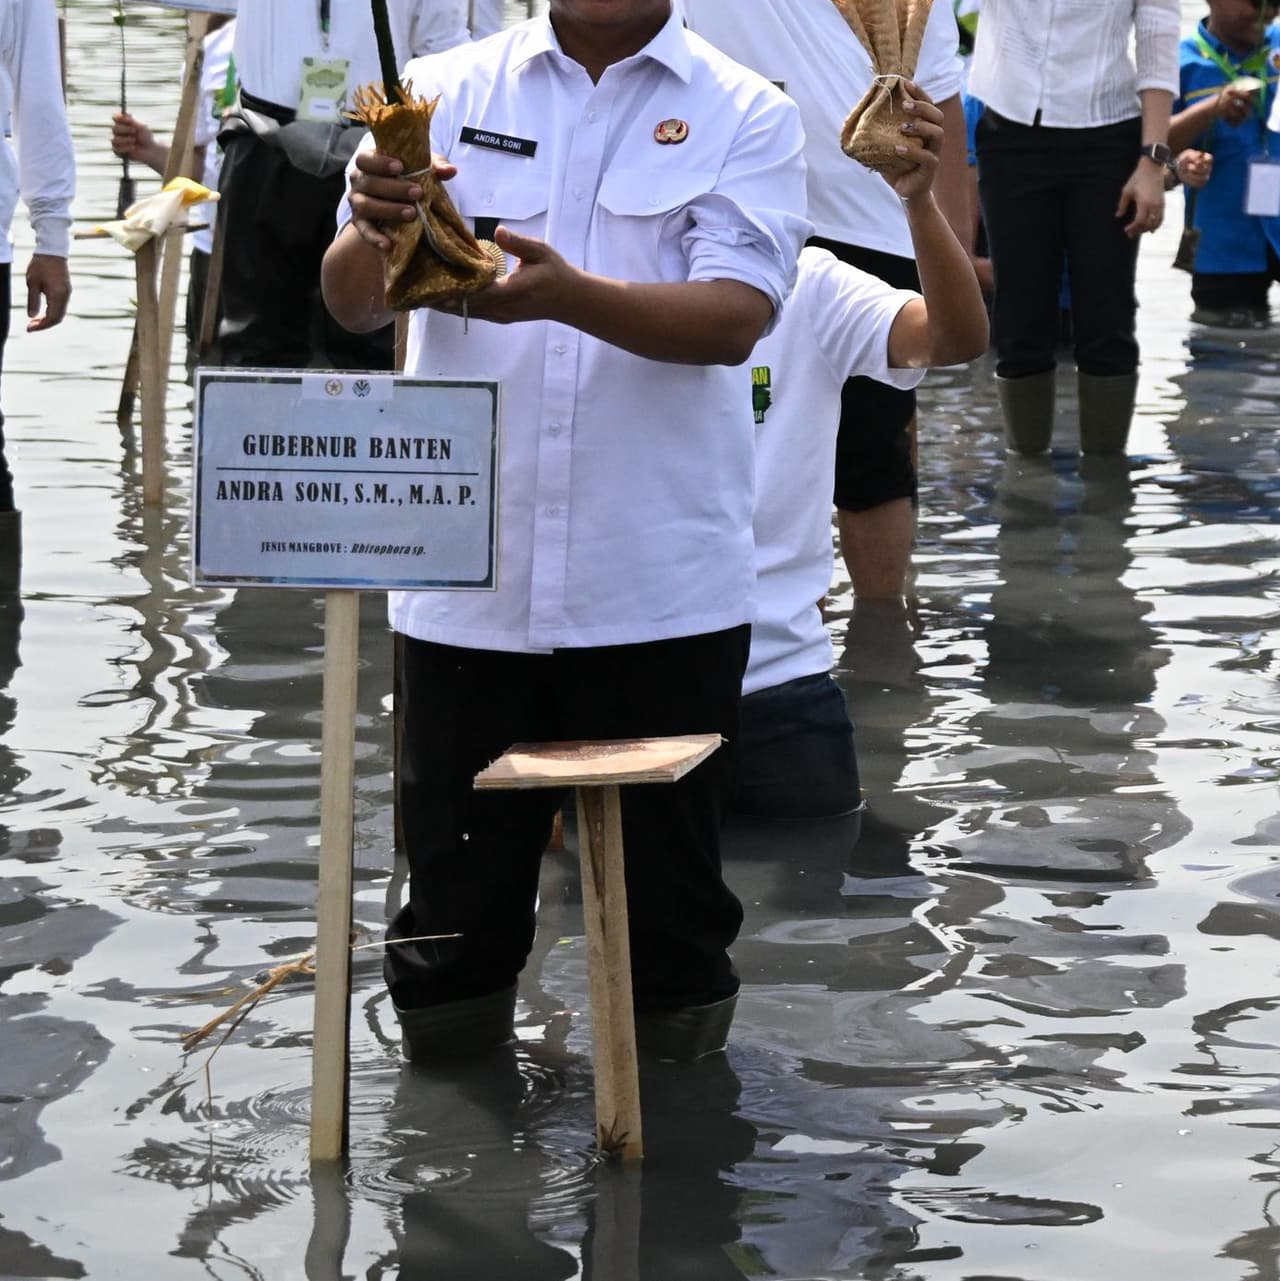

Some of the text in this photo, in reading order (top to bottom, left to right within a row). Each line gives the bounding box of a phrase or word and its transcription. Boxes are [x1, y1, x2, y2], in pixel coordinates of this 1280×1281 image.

[474, 133, 521, 150] ANDRA SONI
[243, 434, 452, 460] GUBERNUR BANTEN
[216, 480, 283, 502] ANDRA
[296, 481, 348, 505] SONI,
[355, 483, 402, 506] S.M.,
[261, 541, 286, 553] JENIS
[289, 542, 342, 553] MANGROVE
[351, 543, 412, 555] Rhizophora
[412, 545, 426, 556] sp.
